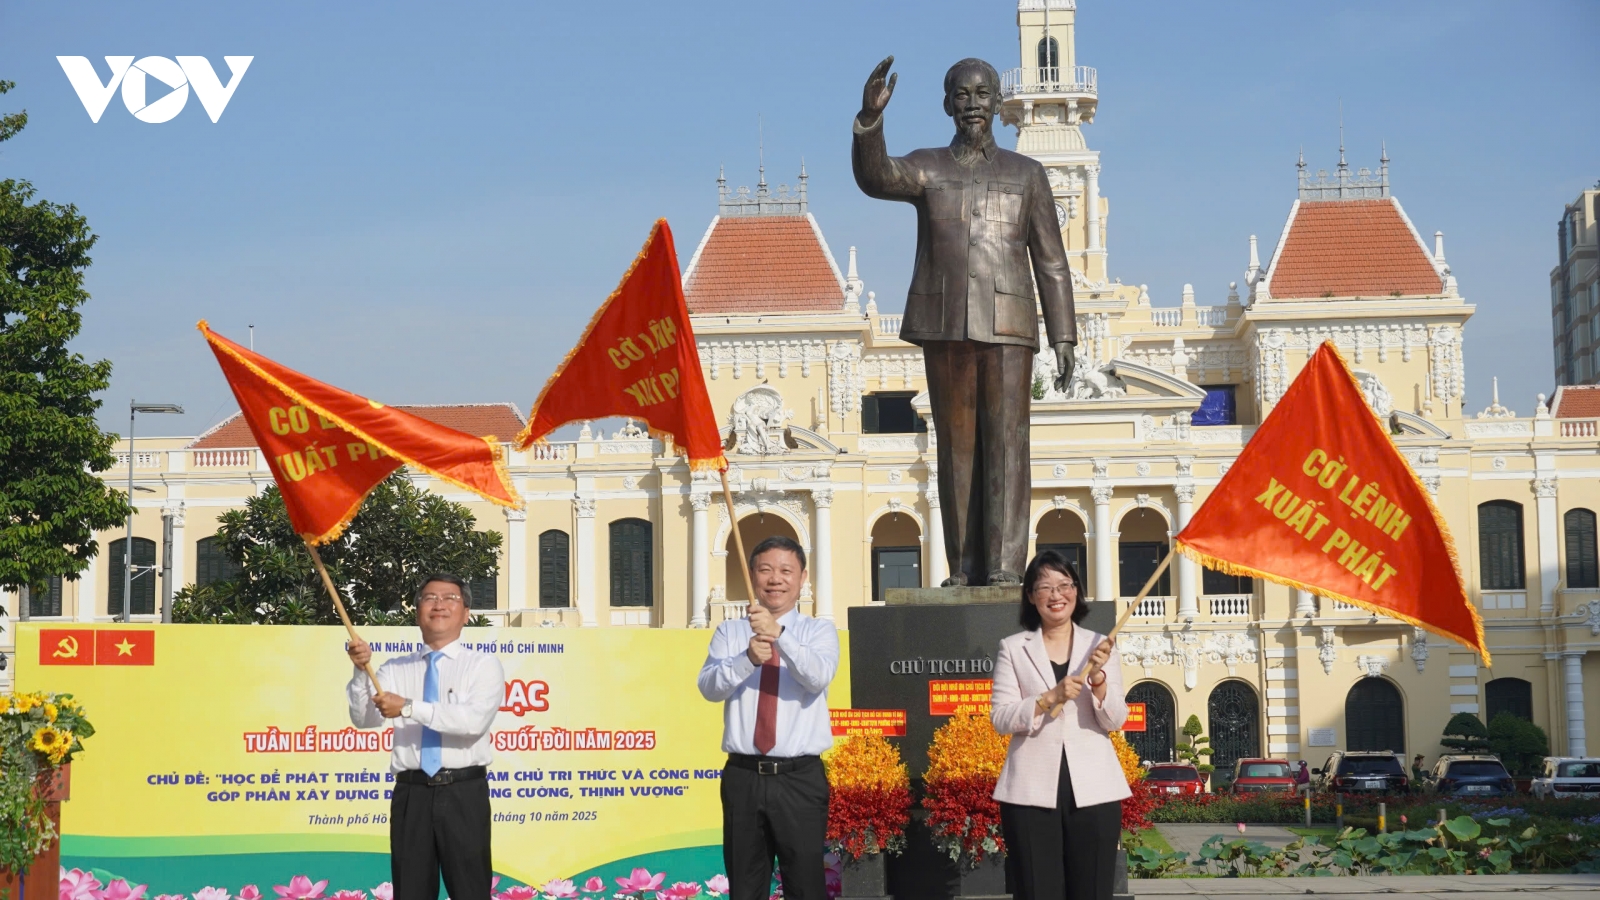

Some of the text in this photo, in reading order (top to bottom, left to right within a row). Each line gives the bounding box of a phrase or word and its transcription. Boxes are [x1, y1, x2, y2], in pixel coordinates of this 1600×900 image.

[607, 336, 645, 370] CỜ
[268, 399, 310, 436] CỜ
[1302, 448, 1413, 542] CỜ LỆNH
[1254, 477, 1398, 592] XUẤT PHÁT
[369, 641, 382, 652] AN
[385, 640, 413, 652] NHÂN
[476, 639, 497, 653] PHỐ
[500, 639, 514, 653] HỒ
[517, 641, 535, 653] CHÍ
[538, 643, 564, 653] MINH
[890, 655, 994, 676] CHỦ TỊCH HỒ
[499, 679, 549, 717] ẠC
[979, 702, 993, 712] DÂN
[244, 726, 292, 753] TUẦN
[294, 725, 317, 753] LỄ
[319, 726, 379, 753] HƯỞNG
[495, 725, 540, 751] SUỐT
[542, 727, 572, 751] ĐỜI
[574, 727, 612, 751] NĂM
[614, 730, 656, 751] 2025
[147, 771, 180, 785] CHỦ
[215, 773, 256, 786] "HỌC
[260, 769, 281, 784] ĐỂ
[285, 771, 329, 784] PHÁT
[334, 768, 381, 783] TRIỂN
[486, 769, 509, 782] ÀM
[514, 768, 543, 781] CHỦ
[548, 770, 572, 781] TRI
[577, 769, 617, 781] THỨC
[621, 768, 644, 781] VÀ
[649, 767, 690, 780] CÔNG
[693, 769, 725, 779] NGH
[207, 789, 241, 801] GÓP
[295, 788, 330, 800] XÂY
[335, 789, 379, 802] DỰNG
[490, 787, 512, 798] NG
[516, 786, 574, 799] CƯỜNG,
[579, 785, 625, 799] THỊNH
[629, 785, 690, 799] VƯỢNG"
[308, 811, 598, 827] Thành phố Hồ tháng 10 năm 2025
